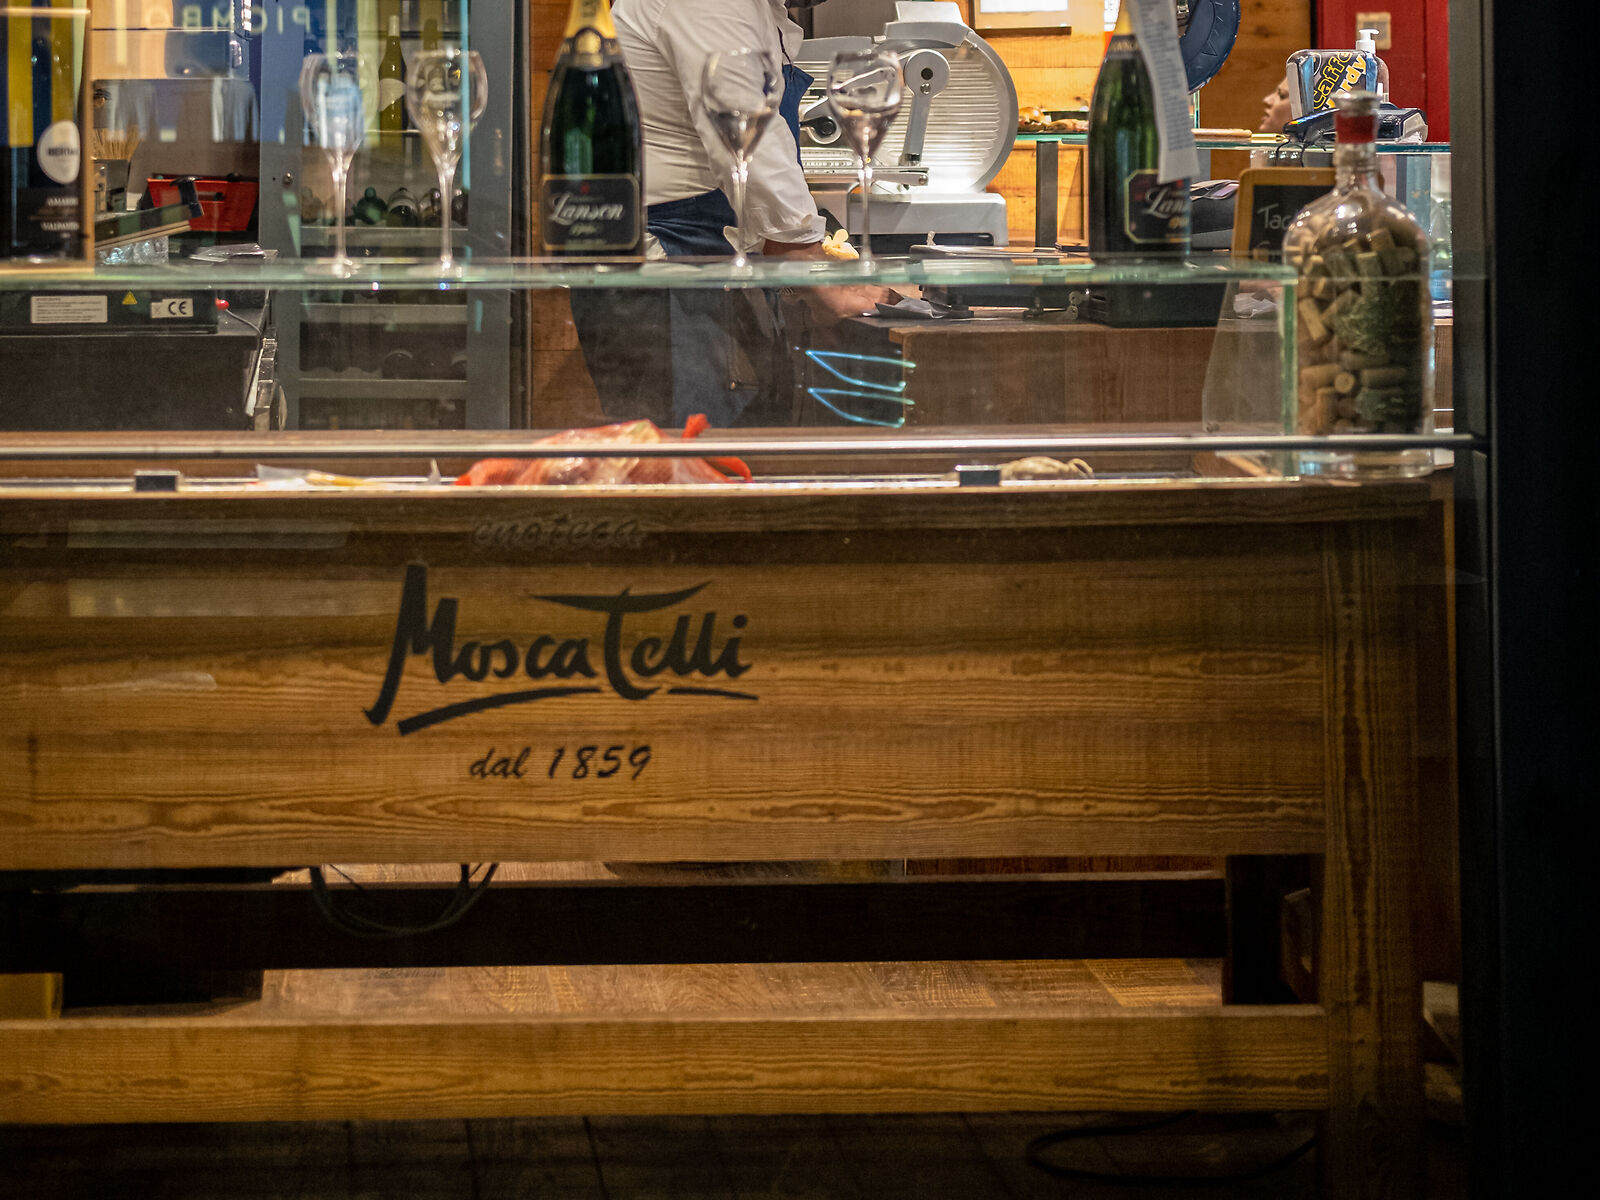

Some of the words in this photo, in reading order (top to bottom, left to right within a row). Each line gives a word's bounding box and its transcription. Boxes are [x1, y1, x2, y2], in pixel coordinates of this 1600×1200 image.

[548, 191, 624, 226] Lanson
[474, 516, 646, 548] enoteca
[469, 747, 532, 780] dal
[547, 744, 653, 781] 1859
